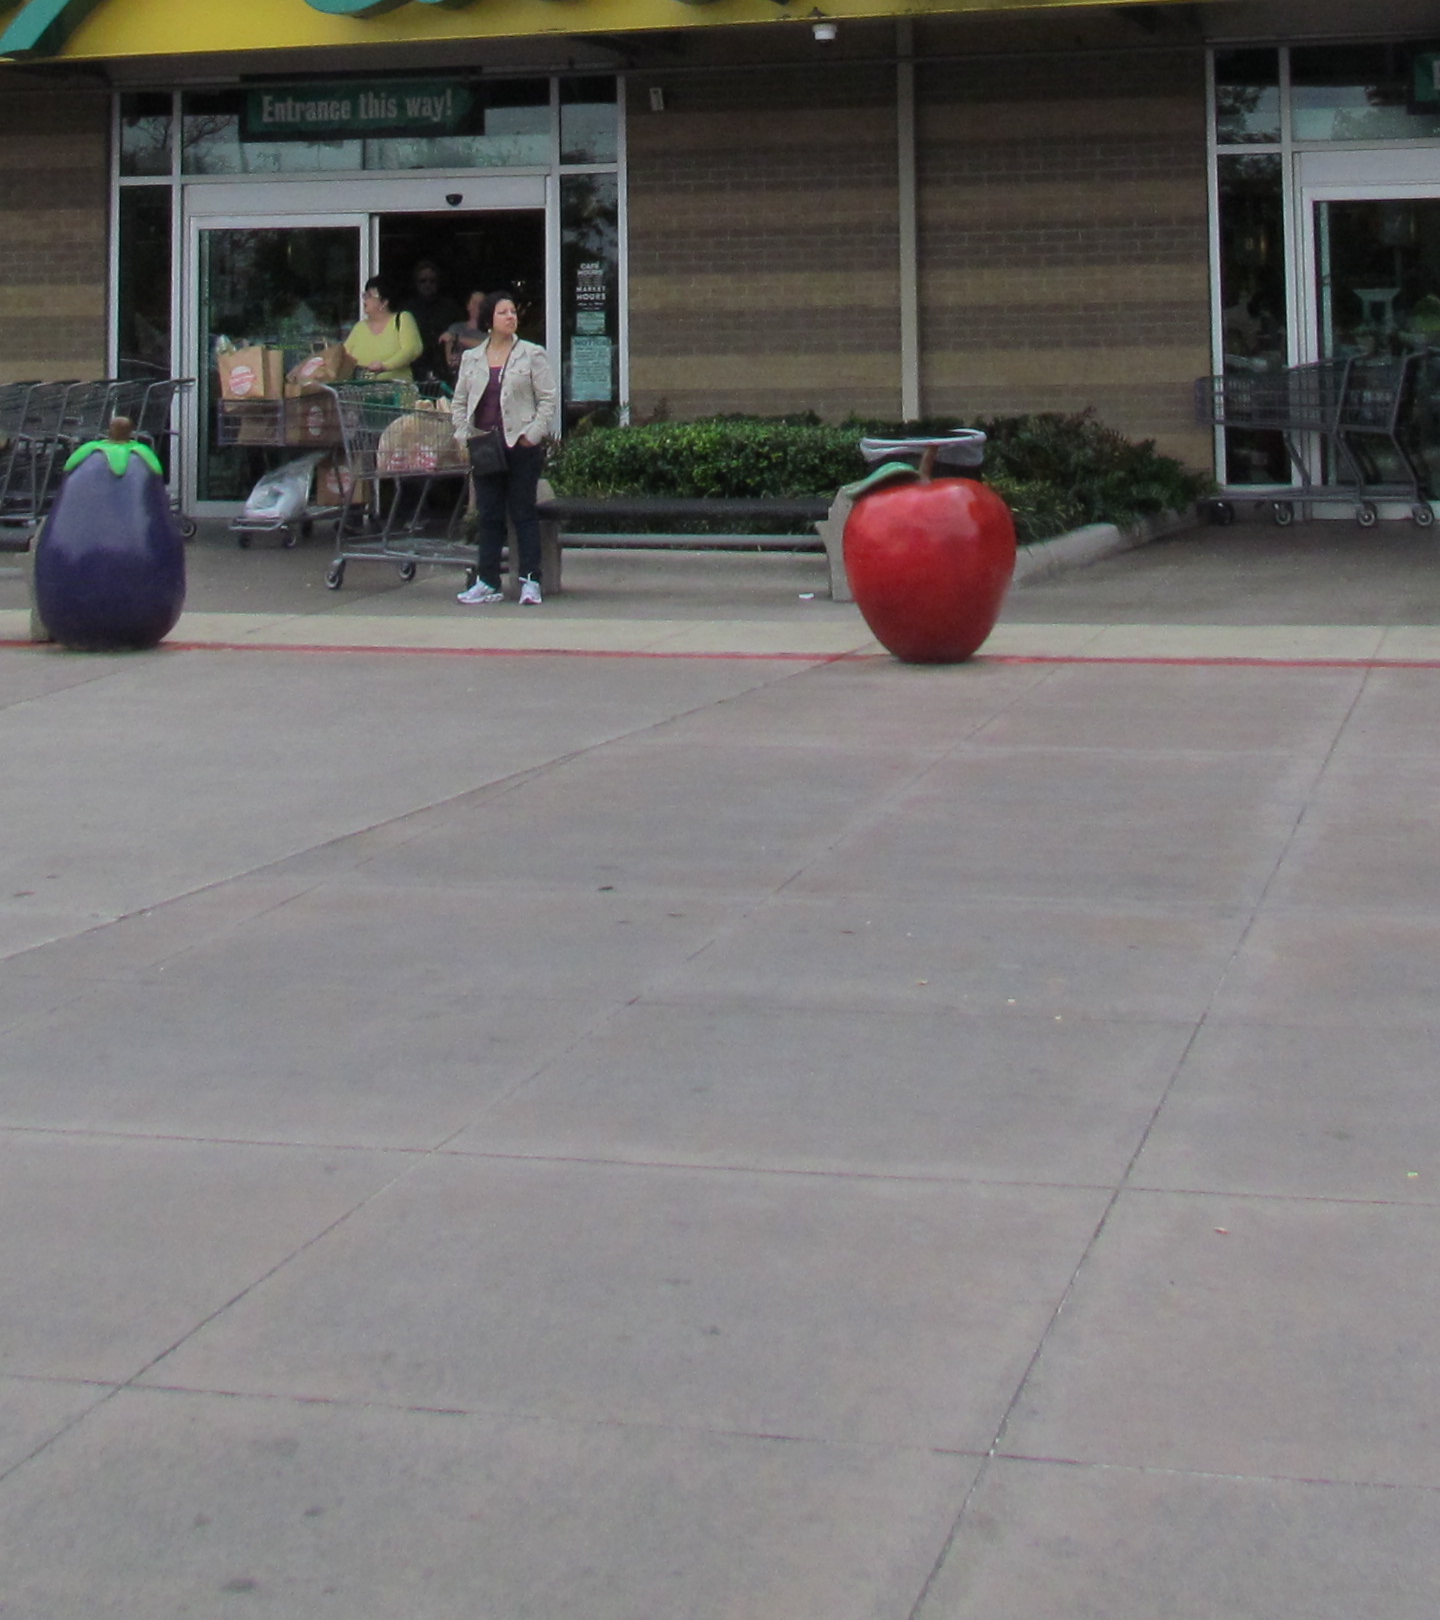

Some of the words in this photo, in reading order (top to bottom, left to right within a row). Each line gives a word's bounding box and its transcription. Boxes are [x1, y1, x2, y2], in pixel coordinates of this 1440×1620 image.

[262, 95, 352, 123] Entrance
[360, 91, 398, 120] this
[406, 88, 452, 122] way!
[576, 293, 607, 301] HOURS
